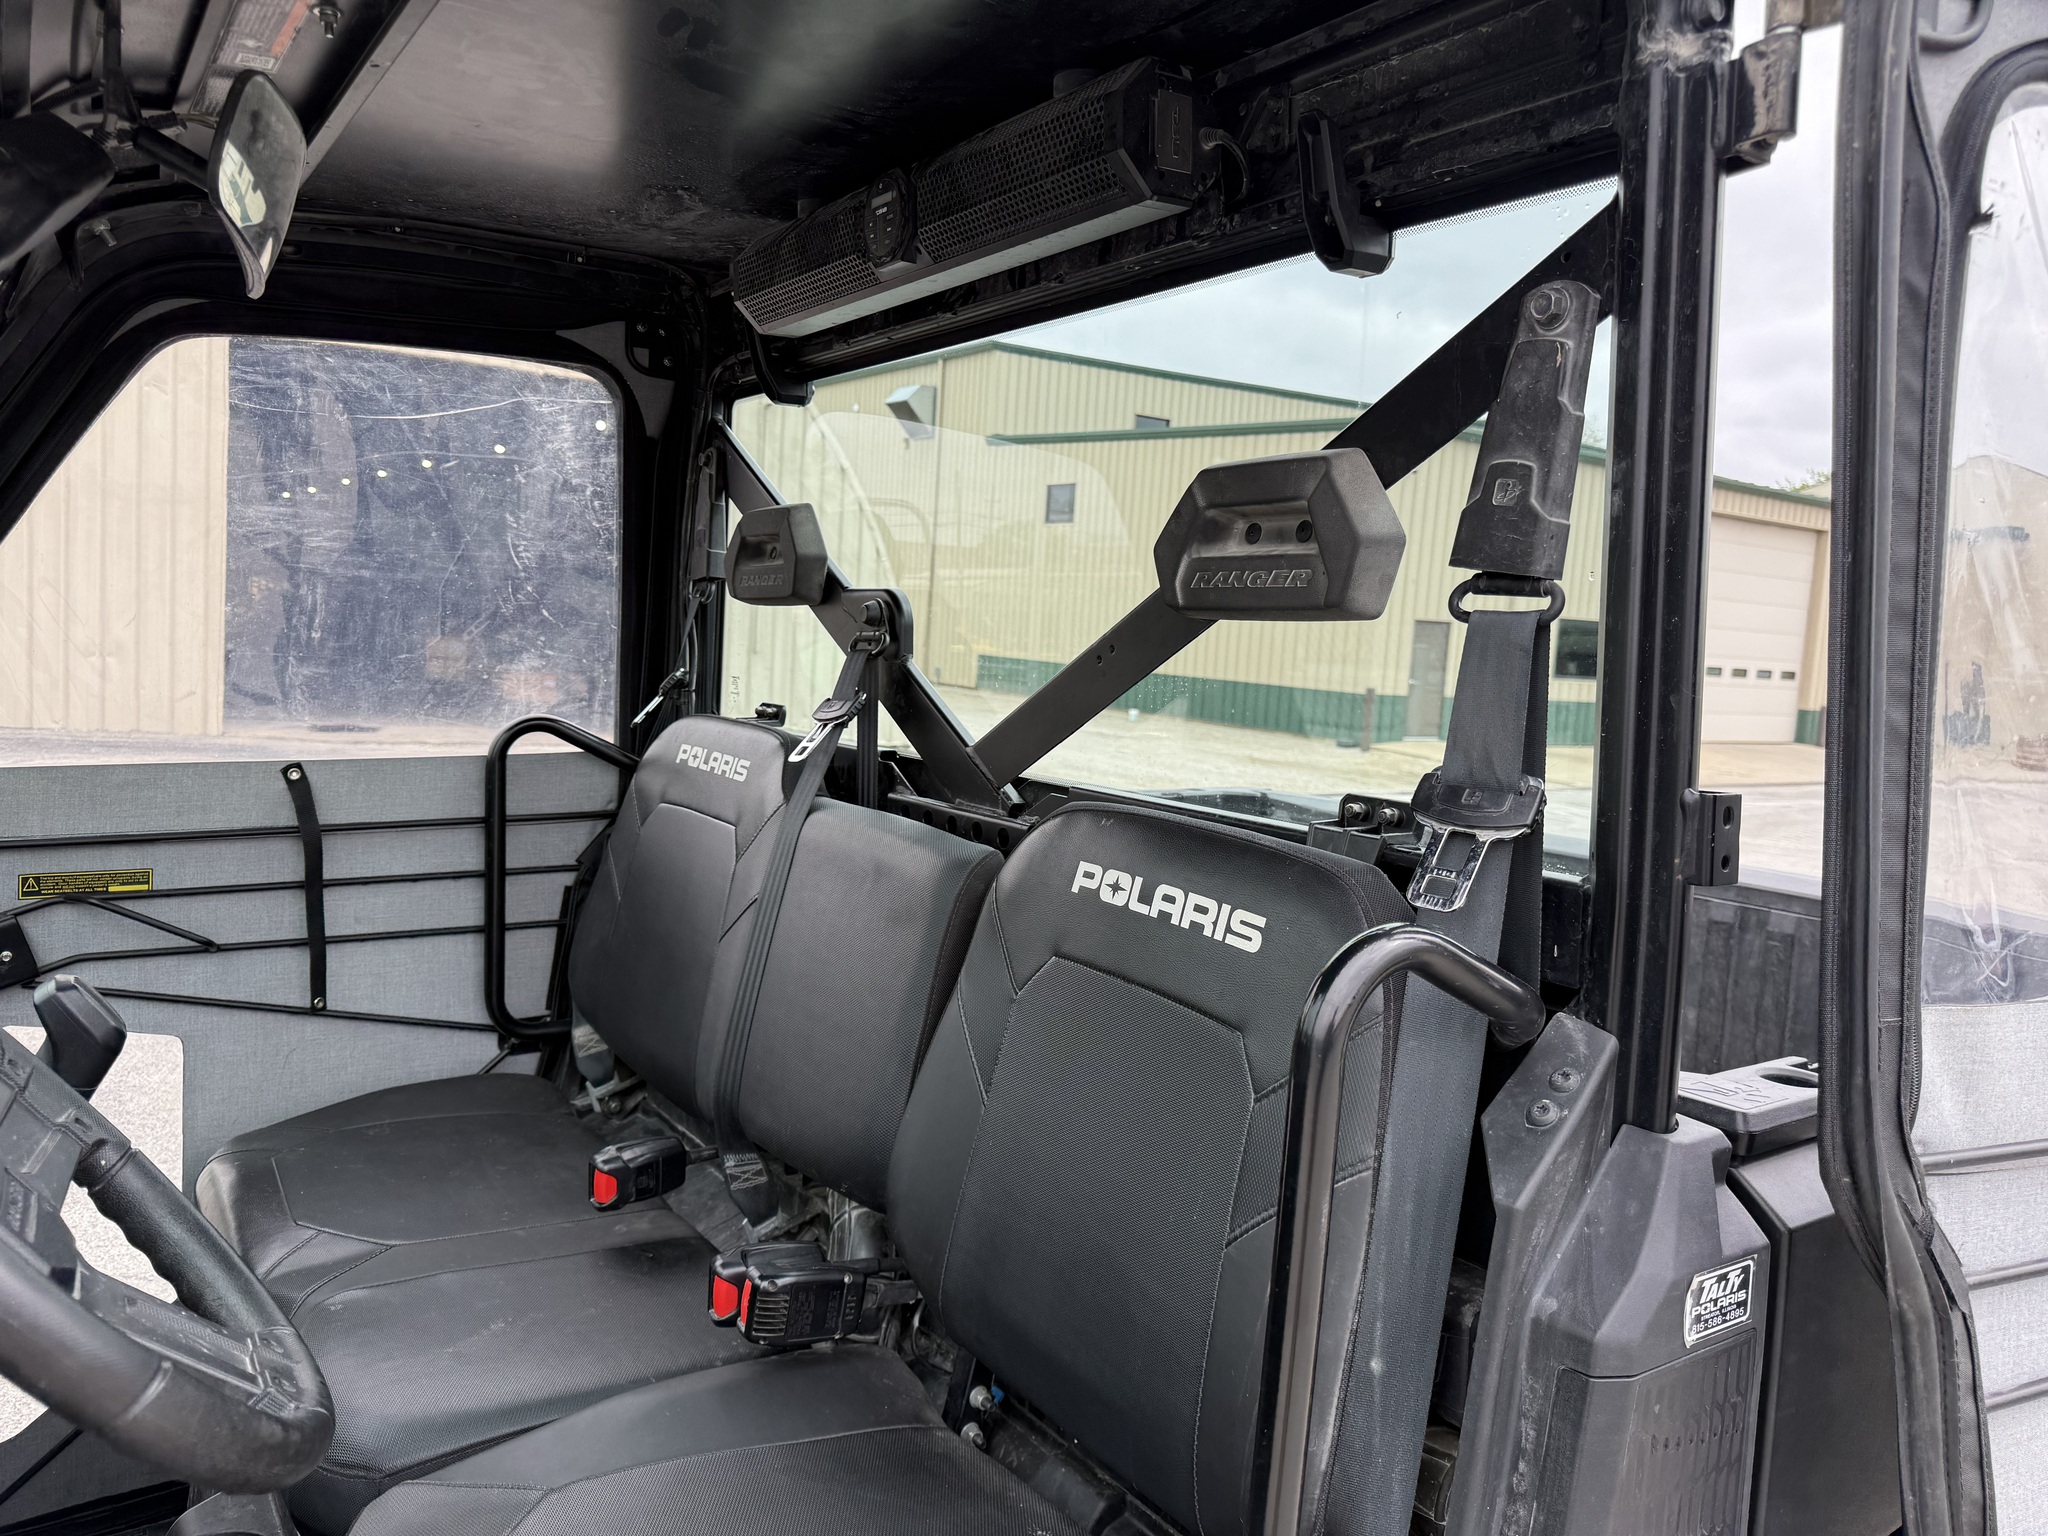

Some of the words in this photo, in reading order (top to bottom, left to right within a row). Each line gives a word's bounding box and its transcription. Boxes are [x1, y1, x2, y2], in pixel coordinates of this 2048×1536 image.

[740, 574, 784, 587] RANGER
[1190, 569, 1313, 589] RANGER
[675, 743, 751, 782] POLARIS
[1071, 860, 1267, 953] POLARIS
[1691, 1289, 1747, 1319] POLARIS
[1691, 1307, 1745, 1334] 815-586-4895
